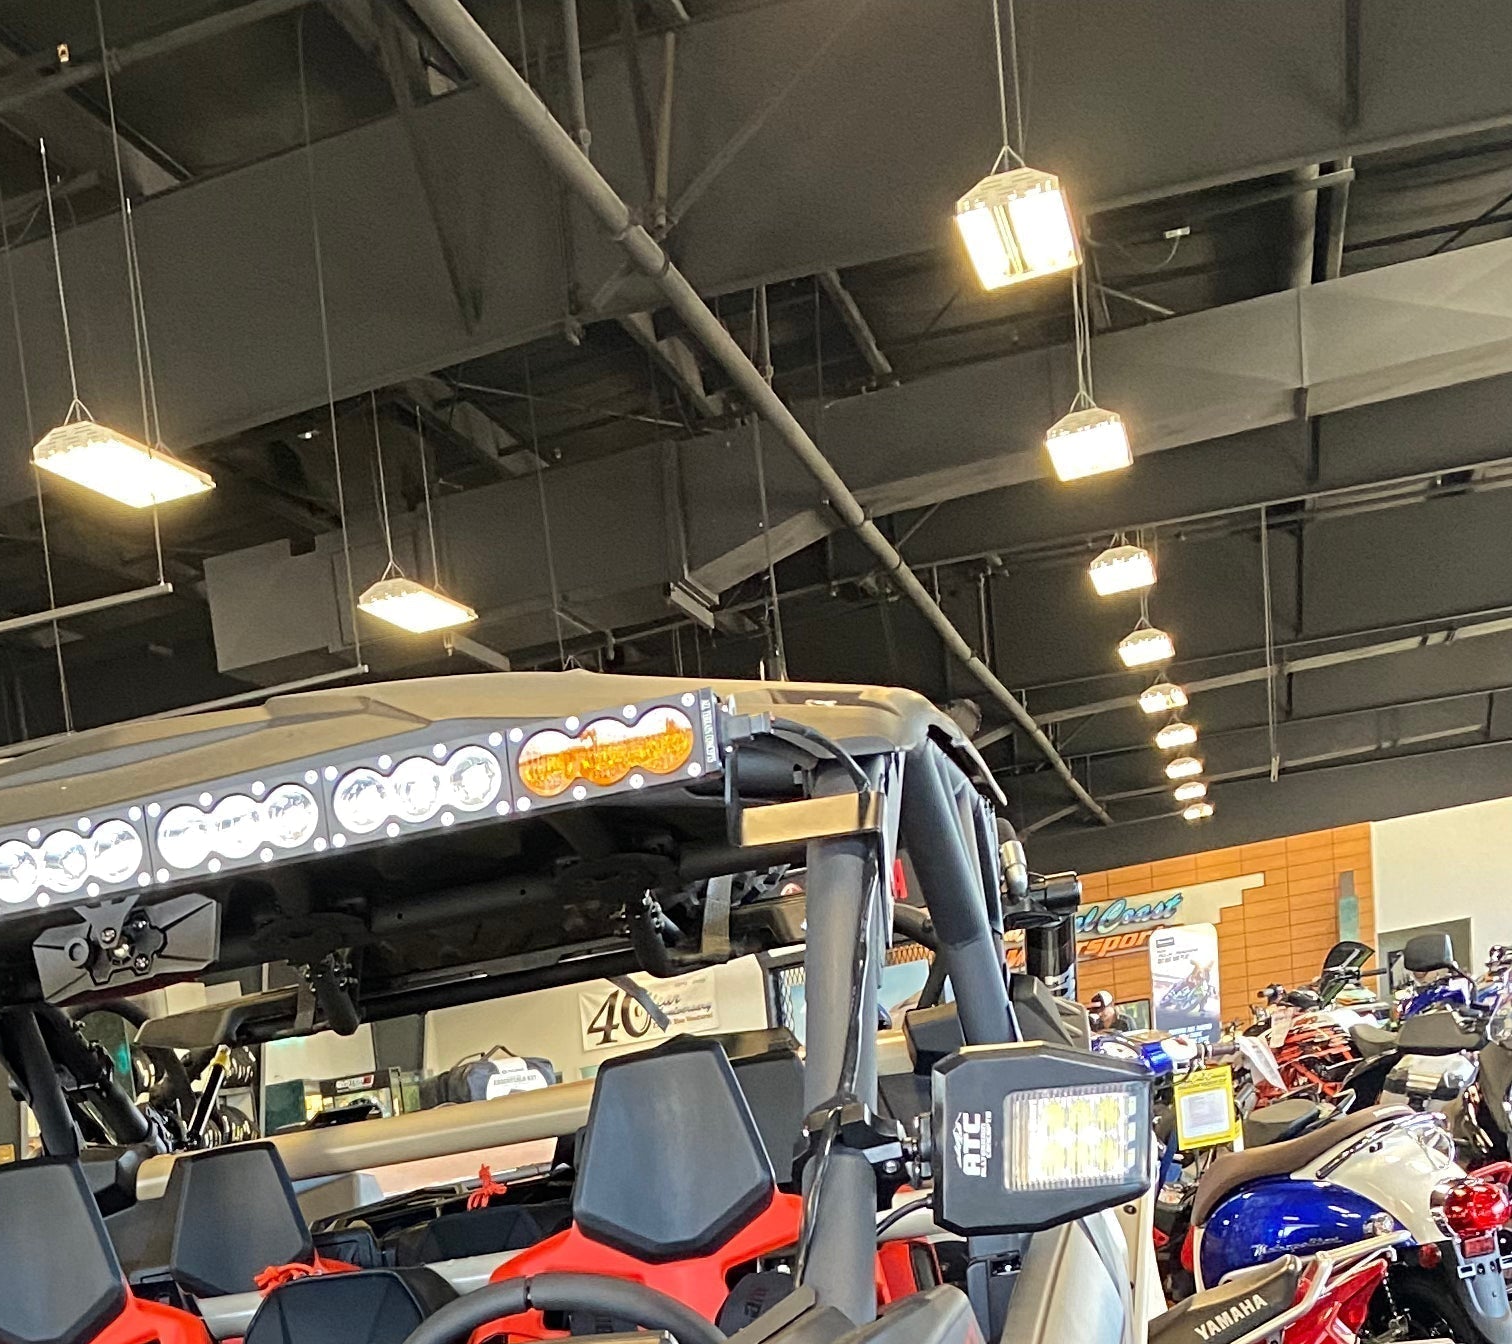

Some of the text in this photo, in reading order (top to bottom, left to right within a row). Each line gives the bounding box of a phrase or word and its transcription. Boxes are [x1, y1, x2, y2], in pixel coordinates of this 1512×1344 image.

[1097, 892, 1184, 935] Coast
[587, 989, 652, 1046] 40
[962, 1112, 981, 1177] ATC
[1193, 1293, 1269, 1342] YAMAHA
